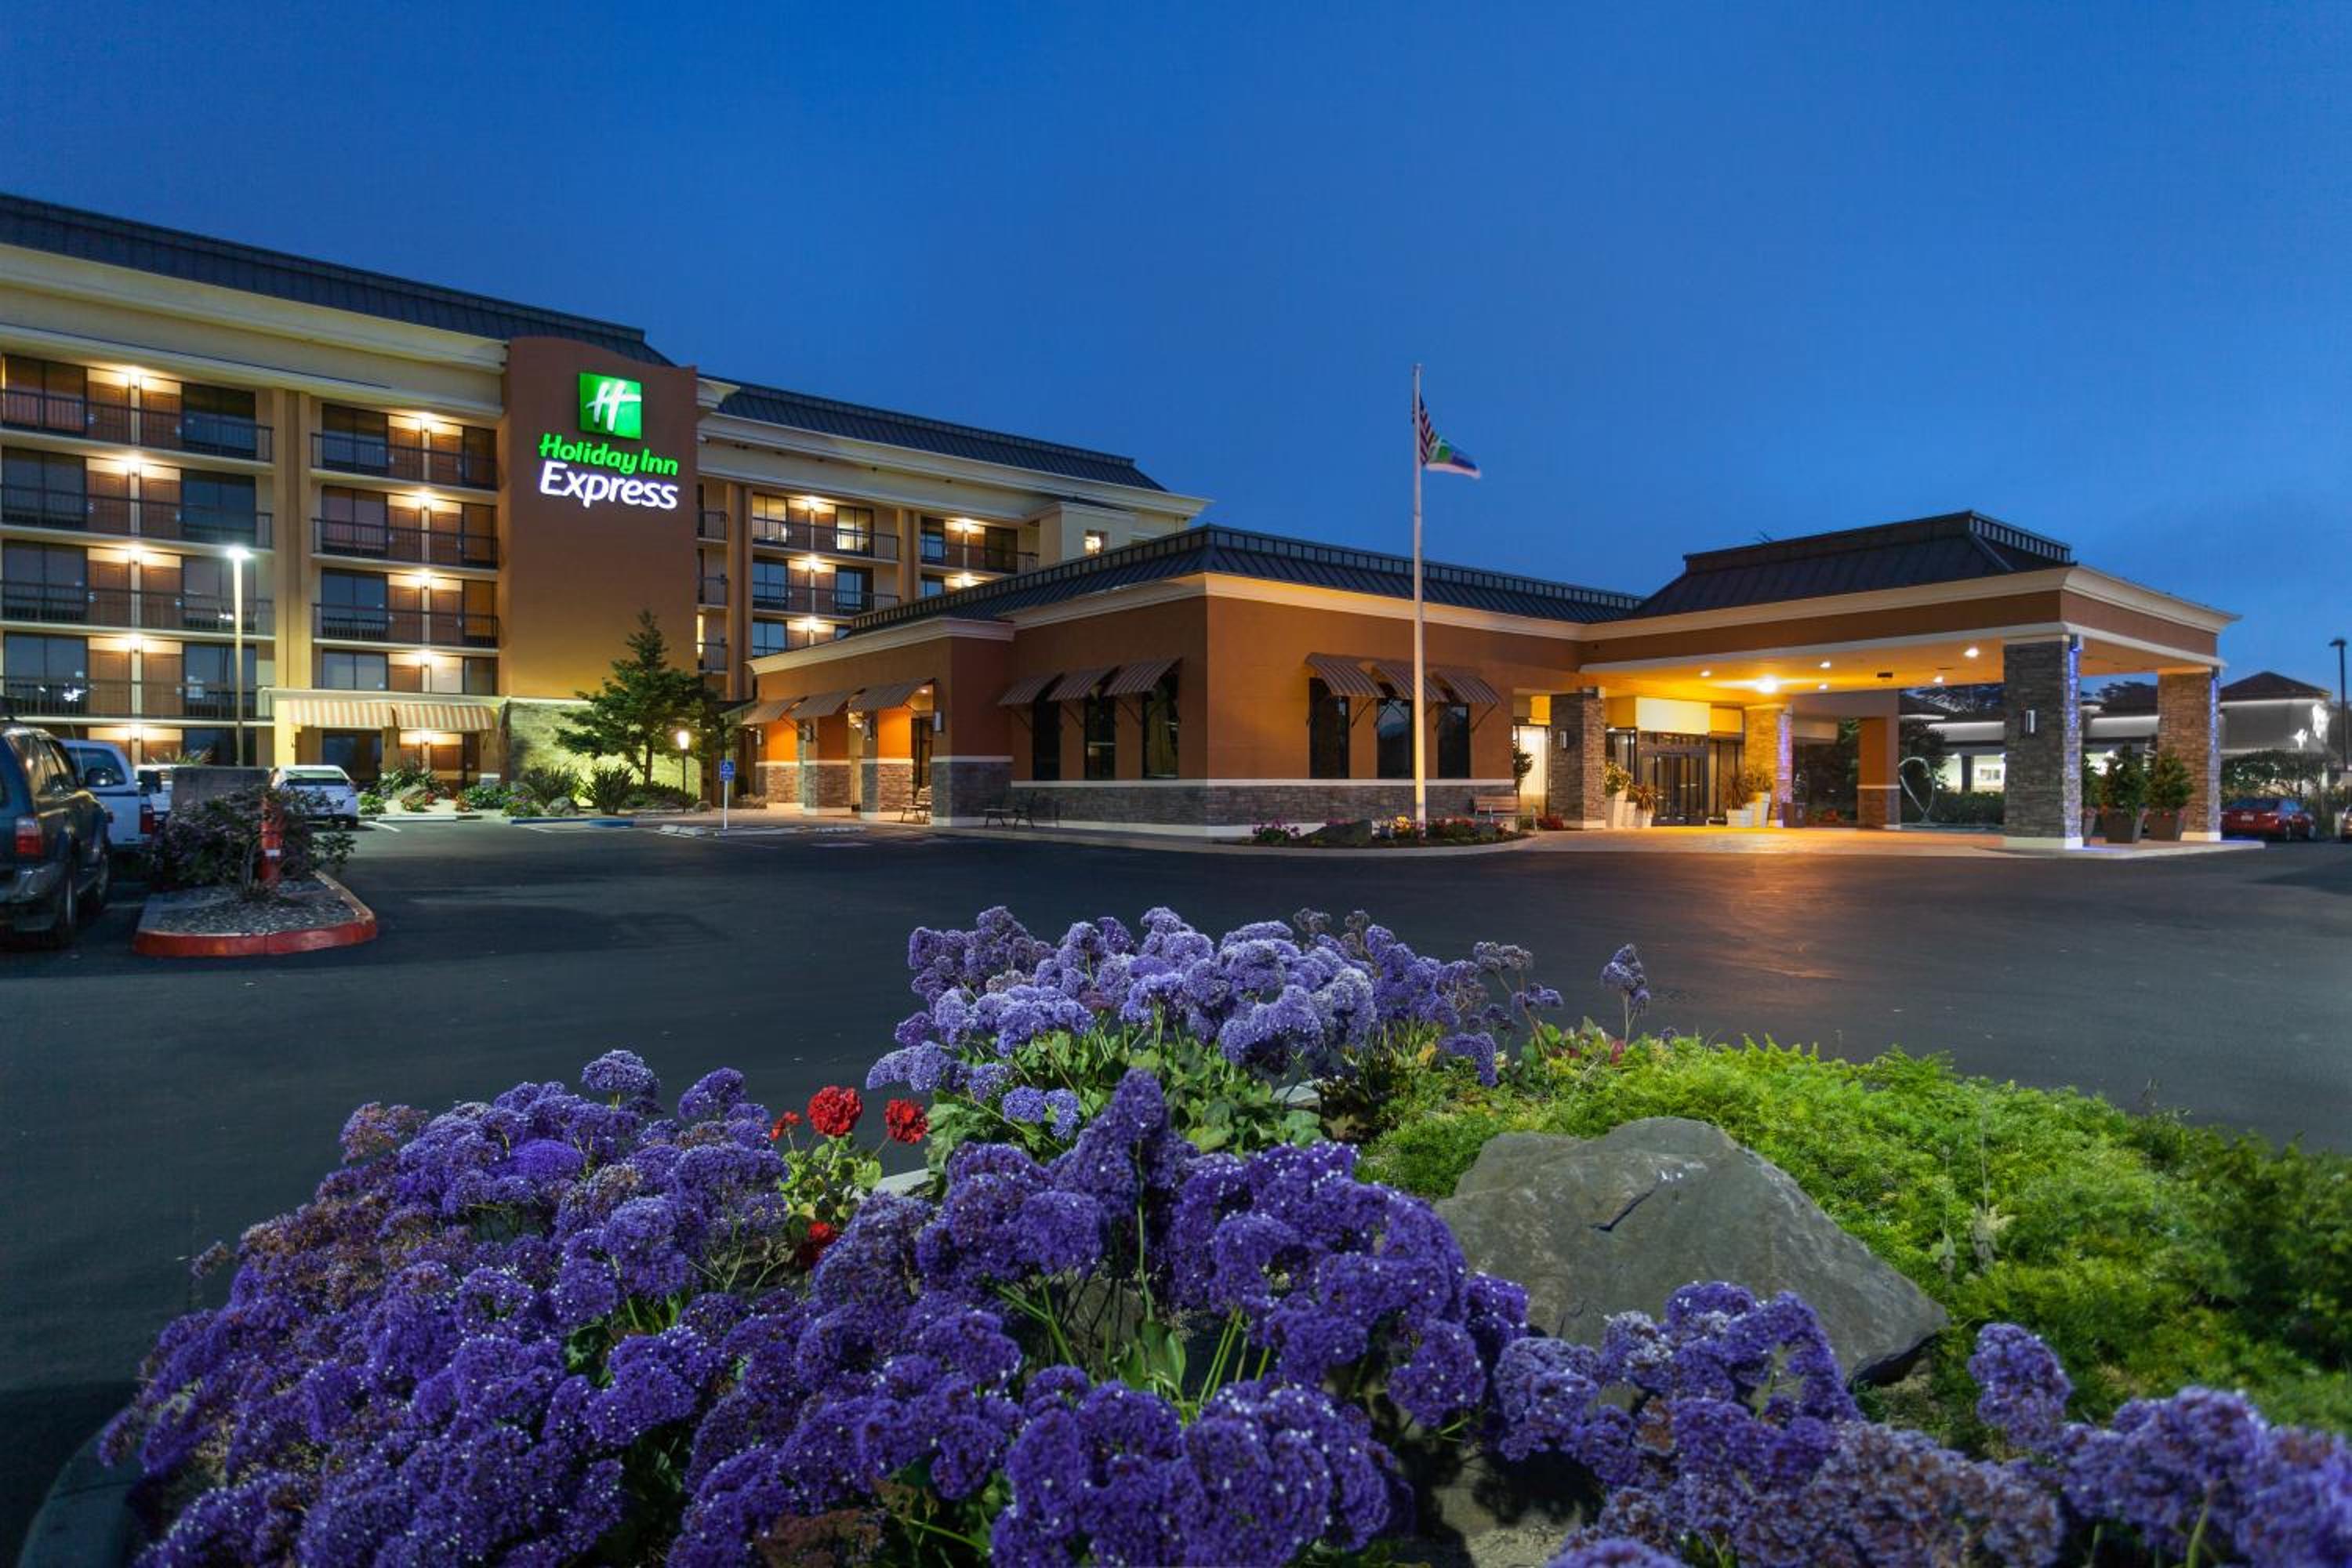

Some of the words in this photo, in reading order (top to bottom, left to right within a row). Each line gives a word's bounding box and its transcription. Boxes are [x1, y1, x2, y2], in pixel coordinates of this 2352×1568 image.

[539, 434, 637, 474] Holiday
[640, 448, 678, 476] Inn
[539, 461, 678, 510] Express
